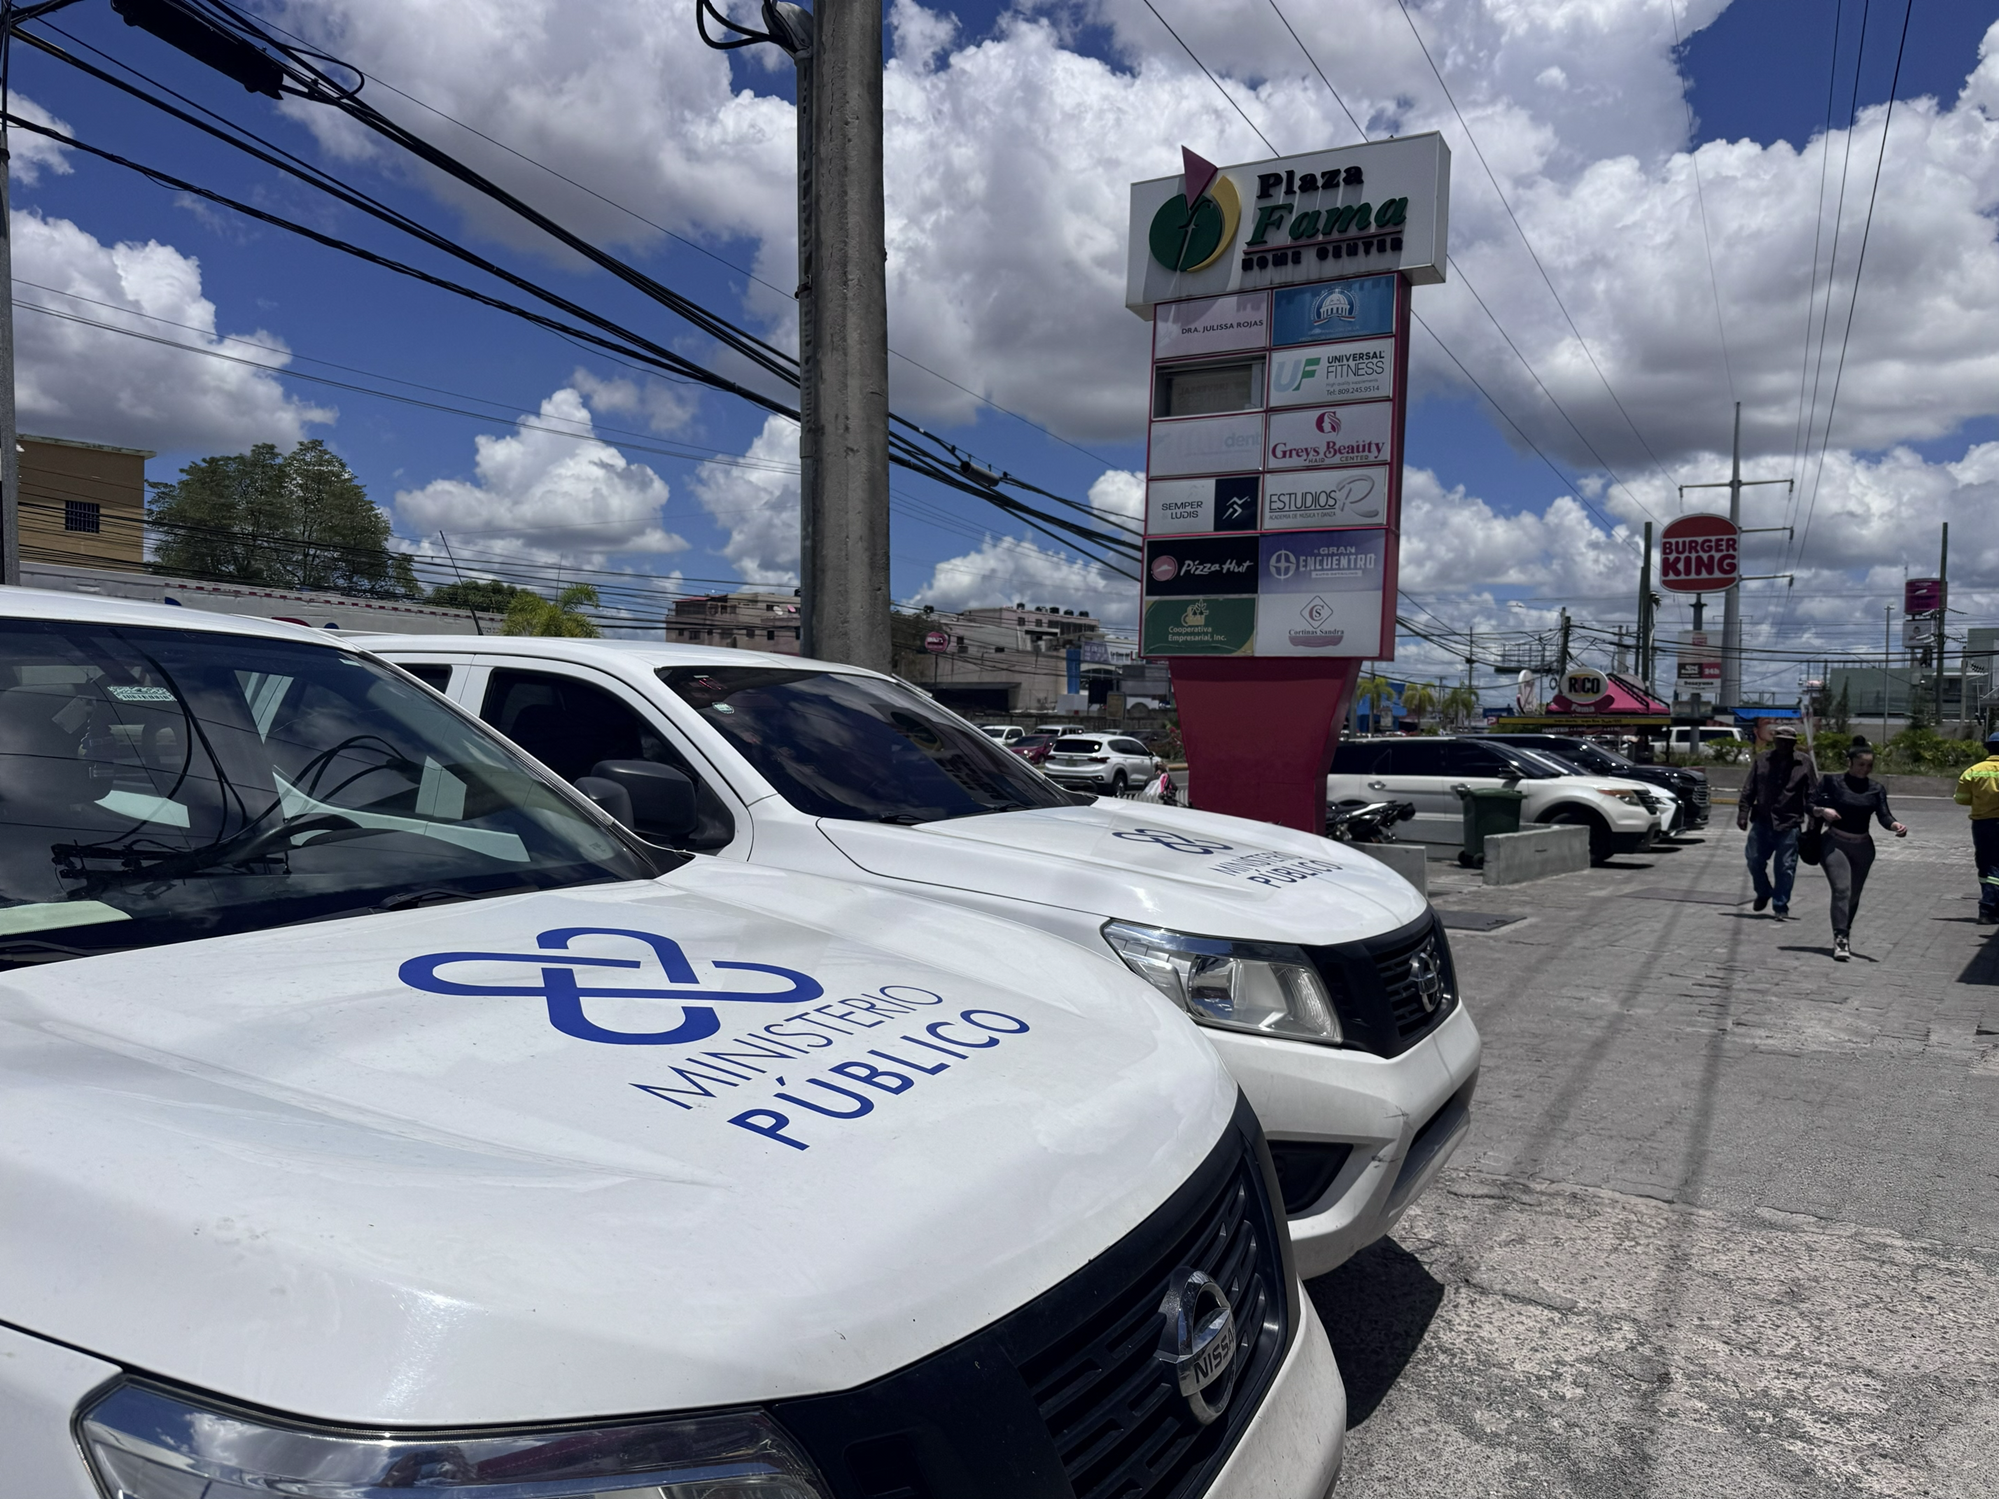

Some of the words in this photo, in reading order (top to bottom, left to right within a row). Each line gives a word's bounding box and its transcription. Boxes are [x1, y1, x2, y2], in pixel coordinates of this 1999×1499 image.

[1256, 166, 1364, 199] Plaza
[1245, 196, 1409, 246] Fama
[1181, 327, 1201, 335] DRA.
[1202, 323, 1235, 333] JULISSA
[1236, 319, 1264, 329] ROJAS
[1327, 351, 1385, 365] UNIVERSAL
[1326, 360, 1385, 380] FITNESS
[1271, 442, 1320, 462] Greys
[1161, 500, 1204, 511] SEMPER
[1268, 489, 1337, 511] ESTUDIOS
[1170, 510, 1199, 520] LUDIS
[1320, 510, 1336, 518] DANZA
[1319, 546, 1356, 554] GRAN
[1662, 537, 1738, 556] BURGER
[1180, 559, 1221, 577] Pizza
[1219, 558, 1254, 574] Hut
[1299, 553, 1375, 571] ENCUENTRO
[1661, 553, 1737, 578] KING
[1168, 625, 1212, 634] Cooperativa
[1168, 633, 1212, 642] Empresarial,
[1288, 628, 1318, 636] Cortinas
[1319, 628, 1345, 636] Sandra
[1568, 676, 1600, 694] RICO
[1246, 859, 1344, 889] PÚBLICO
[628, 983, 945, 1110] MINISTERIO
[726, 1007, 1031, 1152] PÚBLICO
